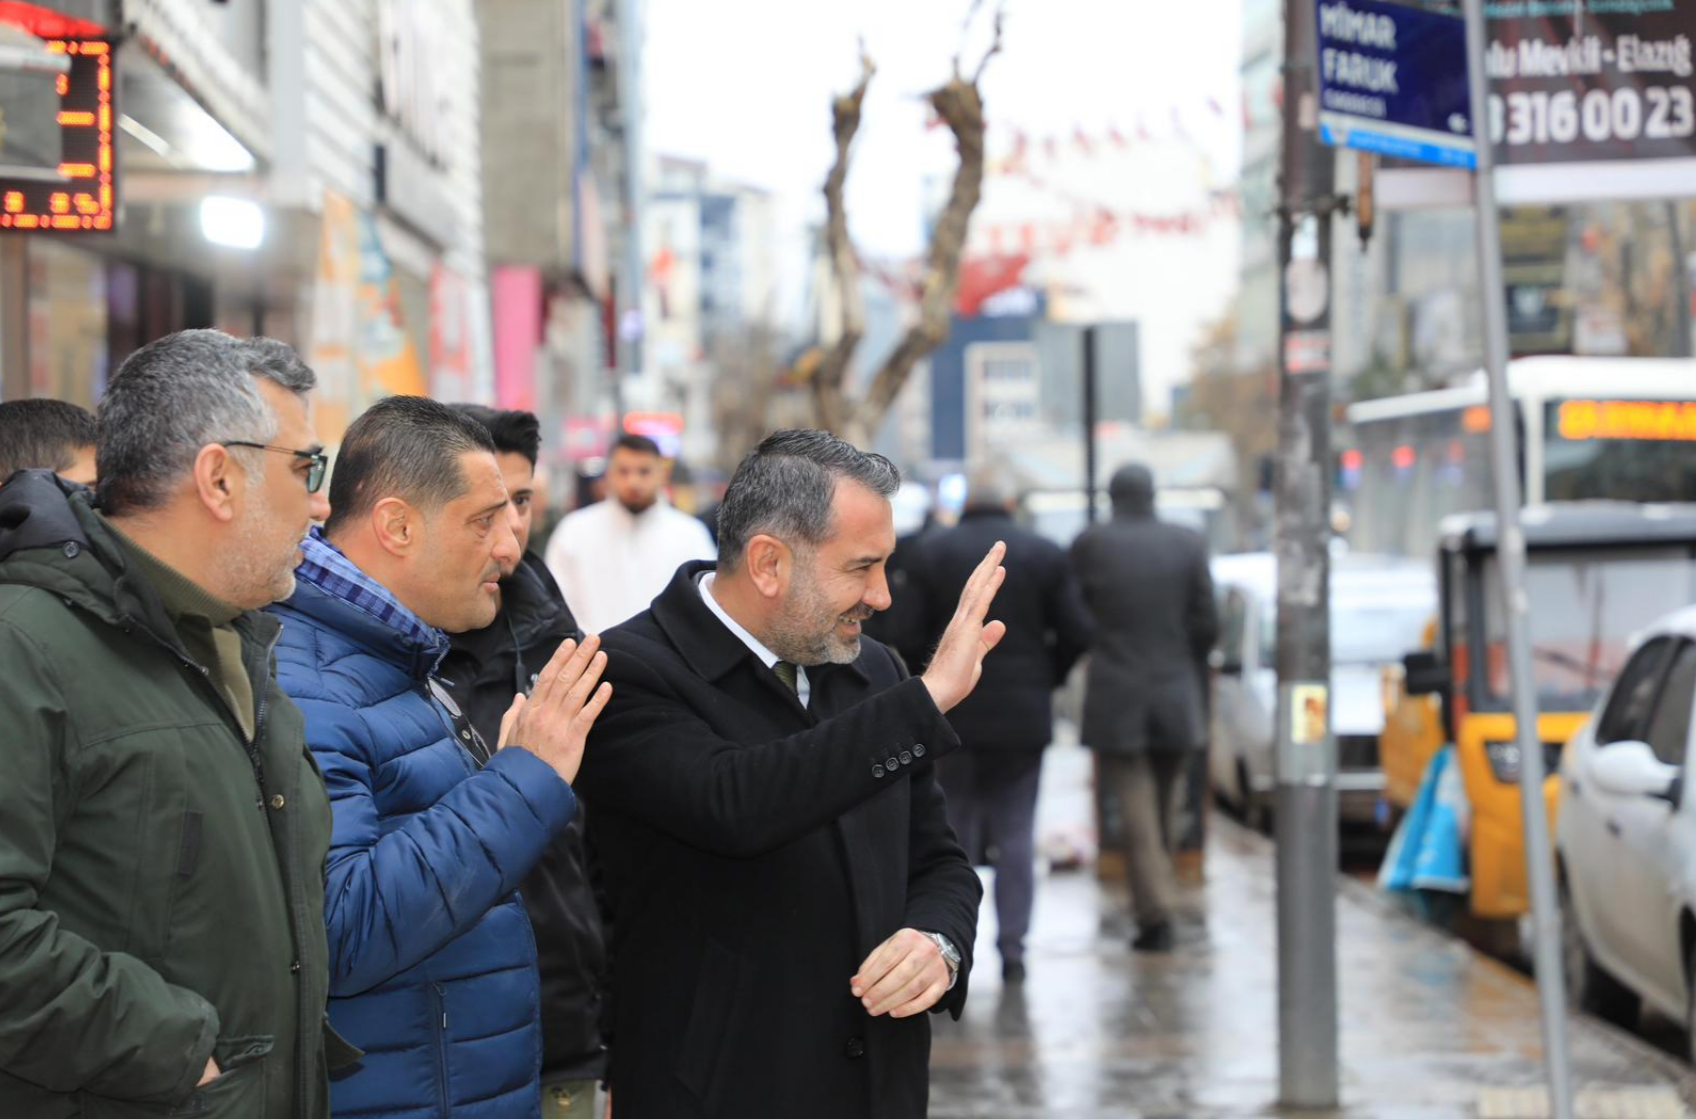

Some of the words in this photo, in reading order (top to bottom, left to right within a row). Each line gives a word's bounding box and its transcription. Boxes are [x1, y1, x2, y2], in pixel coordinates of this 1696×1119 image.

[1320, 1, 1397, 50] MİMAR
[1323, 47, 1399, 95] FARUK
[1617, 33, 1693, 77] Elazığ
[1506, 89, 1579, 145] 316
[1582, 87, 1642, 142] 00
[1645, 84, 1695, 138] 23
